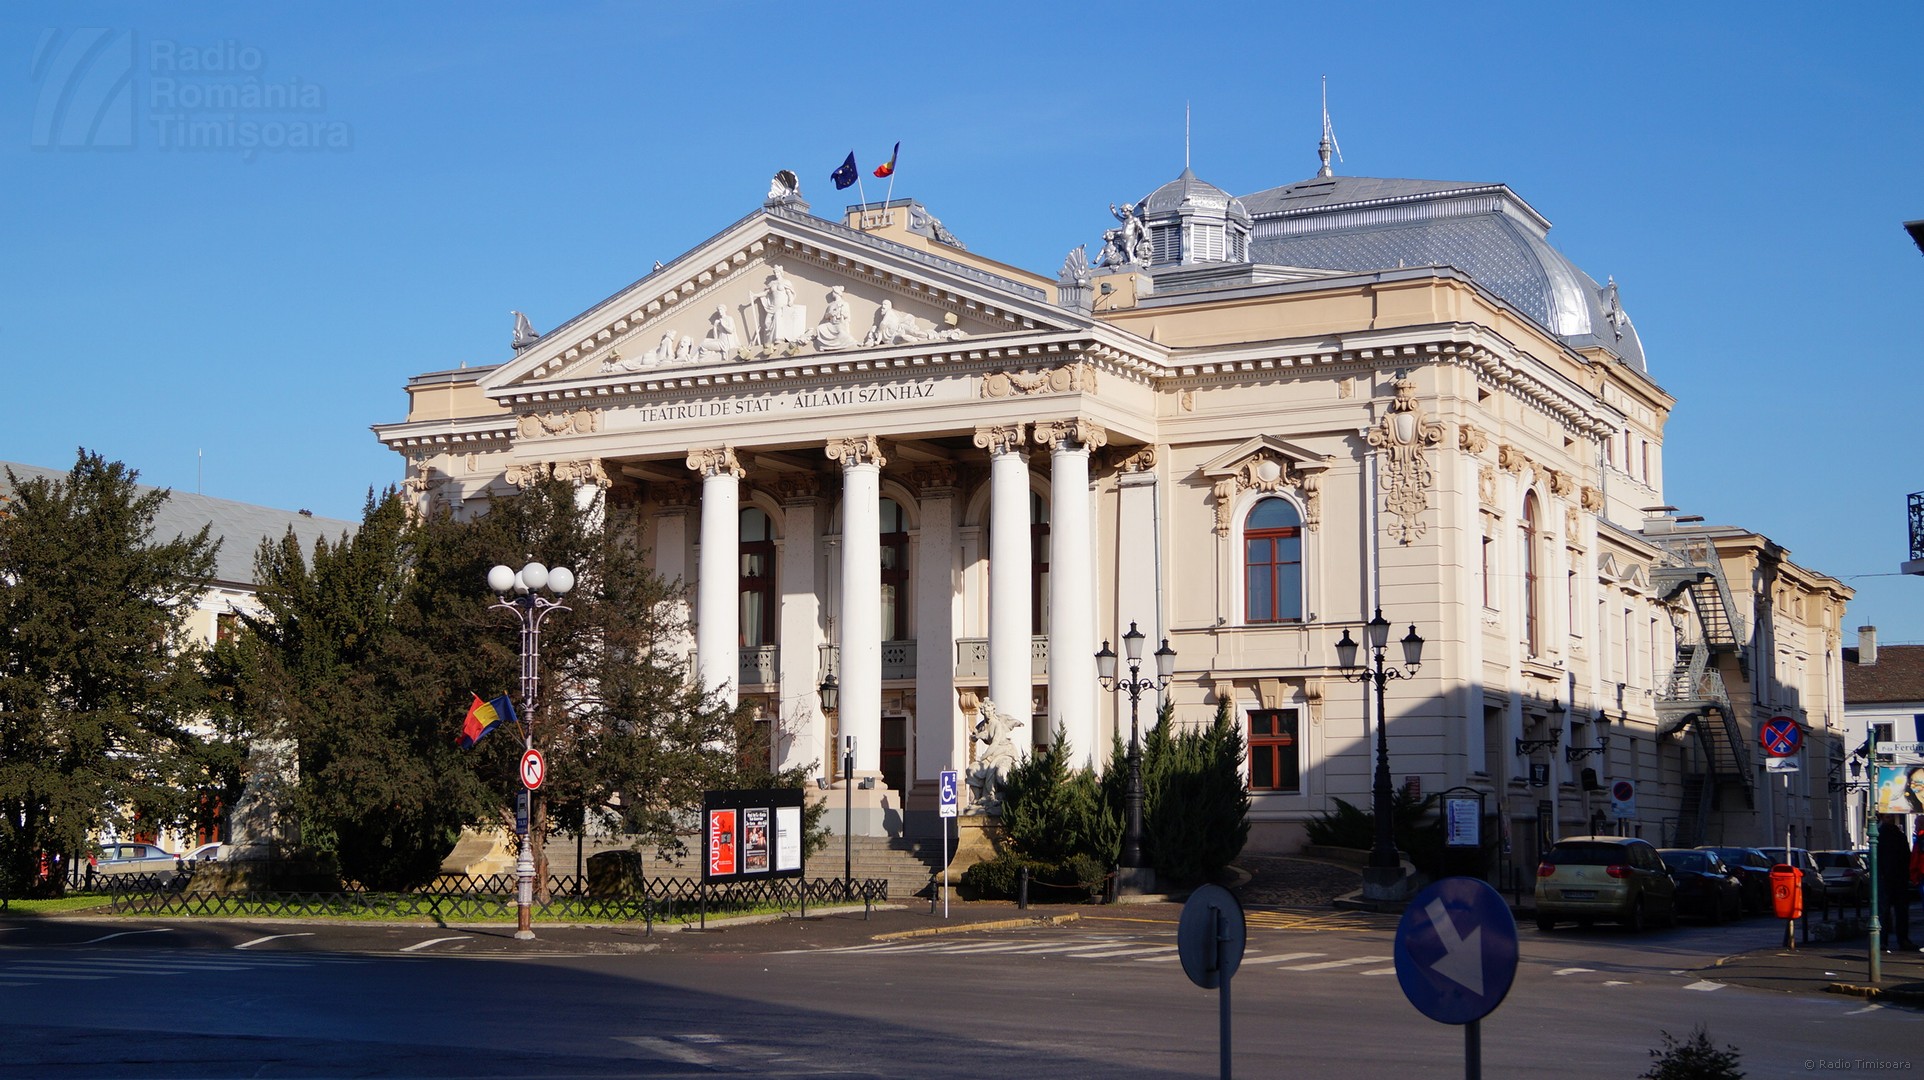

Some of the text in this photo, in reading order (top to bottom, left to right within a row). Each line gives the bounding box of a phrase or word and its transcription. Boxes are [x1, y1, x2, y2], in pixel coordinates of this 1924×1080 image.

[640, 381, 935, 422] TEATRUL DE STAT ÁLLAMI SZÍNHÁZ
